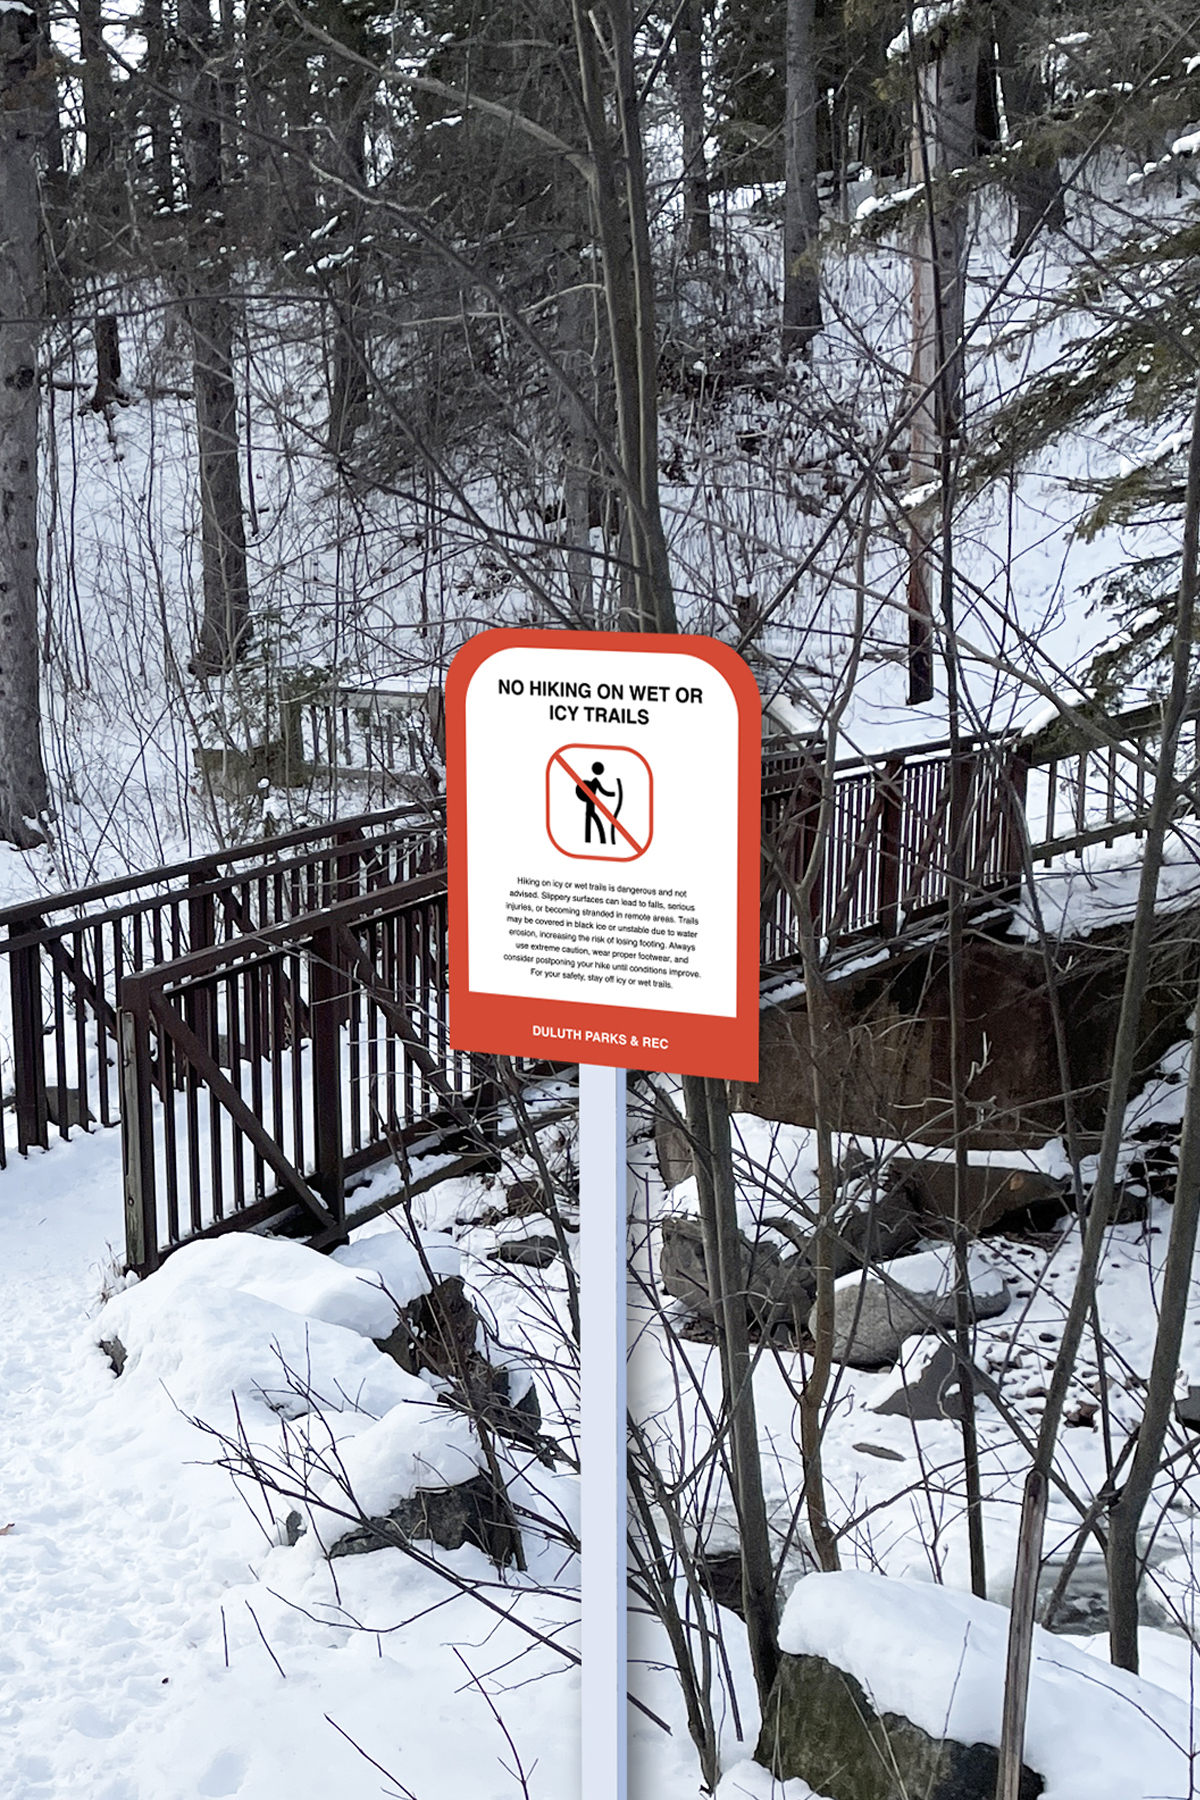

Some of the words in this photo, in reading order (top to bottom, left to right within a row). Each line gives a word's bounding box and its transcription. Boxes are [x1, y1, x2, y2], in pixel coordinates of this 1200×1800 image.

[499, 679, 524, 696] NO
[530, 680, 591, 699] HIKING
[597, 683, 623, 700] ON
[629, 685, 670, 702] WET
[675, 687, 703, 704] OR
[550, 705, 579, 721] ICY
[583, 706, 649, 725] TRAILS
[517, 877, 540, 888] Hiking
[553, 880, 563, 889] icy
[574, 882, 588, 890] wet
[589, 883, 607, 892] trails
[608, 883, 615, 892] is
[616, 885, 657, 896] dangerous
[658, 888, 673, 897] and
[674, 890, 687, 898] not
[509, 890, 539, 899] advised.
[541, 891, 571, 903] Slippery
[572, 895, 604, 904] surfaces
[621, 898, 637, 907] lead
[638, 900, 647, 908] to
[647, 900, 666, 910] falls,
[667, 903, 696, 912] serious
[506, 902, 534, 912] injuries,
[535, 905, 543, 913] or
[544, 905, 580, 917] becoming
[582, 908, 615, 919] stranded
[624, 913, 651, 922] remote
[652, 915, 677, 923] areas.
[678, 915, 699, 926] Trails
[506, 916, 523, 925] may
[524, 916, 534, 925] be
[534, 918, 565, 927] covered
[574, 920, 594, 929] black
[595, 922, 607, 931] ice
[617, 925, 650, 934] unstable
[650, 927, 666, 936] due
[667, 929, 675, 937] to
[676, 930, 698, 938] water
[508, 929, 538, 938] erosion,
[539, 931, 577, 943] increasing
[578, 934, 590, 942] the
[591, 935, 605, 943] risk
[606, 936, 615, 945] of
[615, 937, 638, 948] losing
[639, 939, 668, 951] footing.
[668, 941, 696, 953] Always
[530, 943, 561, 953] extreme
[561, 946, 591, 956] caution,
[591, 949, 611, 957] wear
[611, 951, 637, 959] proper
[638, 951, 673, 963] footwear,
[674, 956, 689, 964] and
[503, 953, 534, 963] consider
[535, 957, 576, 969] postponing
[576, 961, 594, 969] your
[594, 961, 611, 970] hike
[629, 965, 668, 975] conditions
[669, 968, 702, 978] improve.
[530, 967, 543, 977] For
[544, 971, 561, 979] your
[562, 971, 586, 982] safety,
[587, 974, 604, 984] stay
[604, 975, 615, 983] off
[616, 977, 627, 986] icy
[637, 979, 652, 987] wet
[652, 980, 674, 989] trails.
[533, 1025, 581, 1040] DULUTH
[585, 1031, 627, 1045] PARKS
[630, 1036, 638, 1046] &
[643, 1037, 668, 1049] REC
